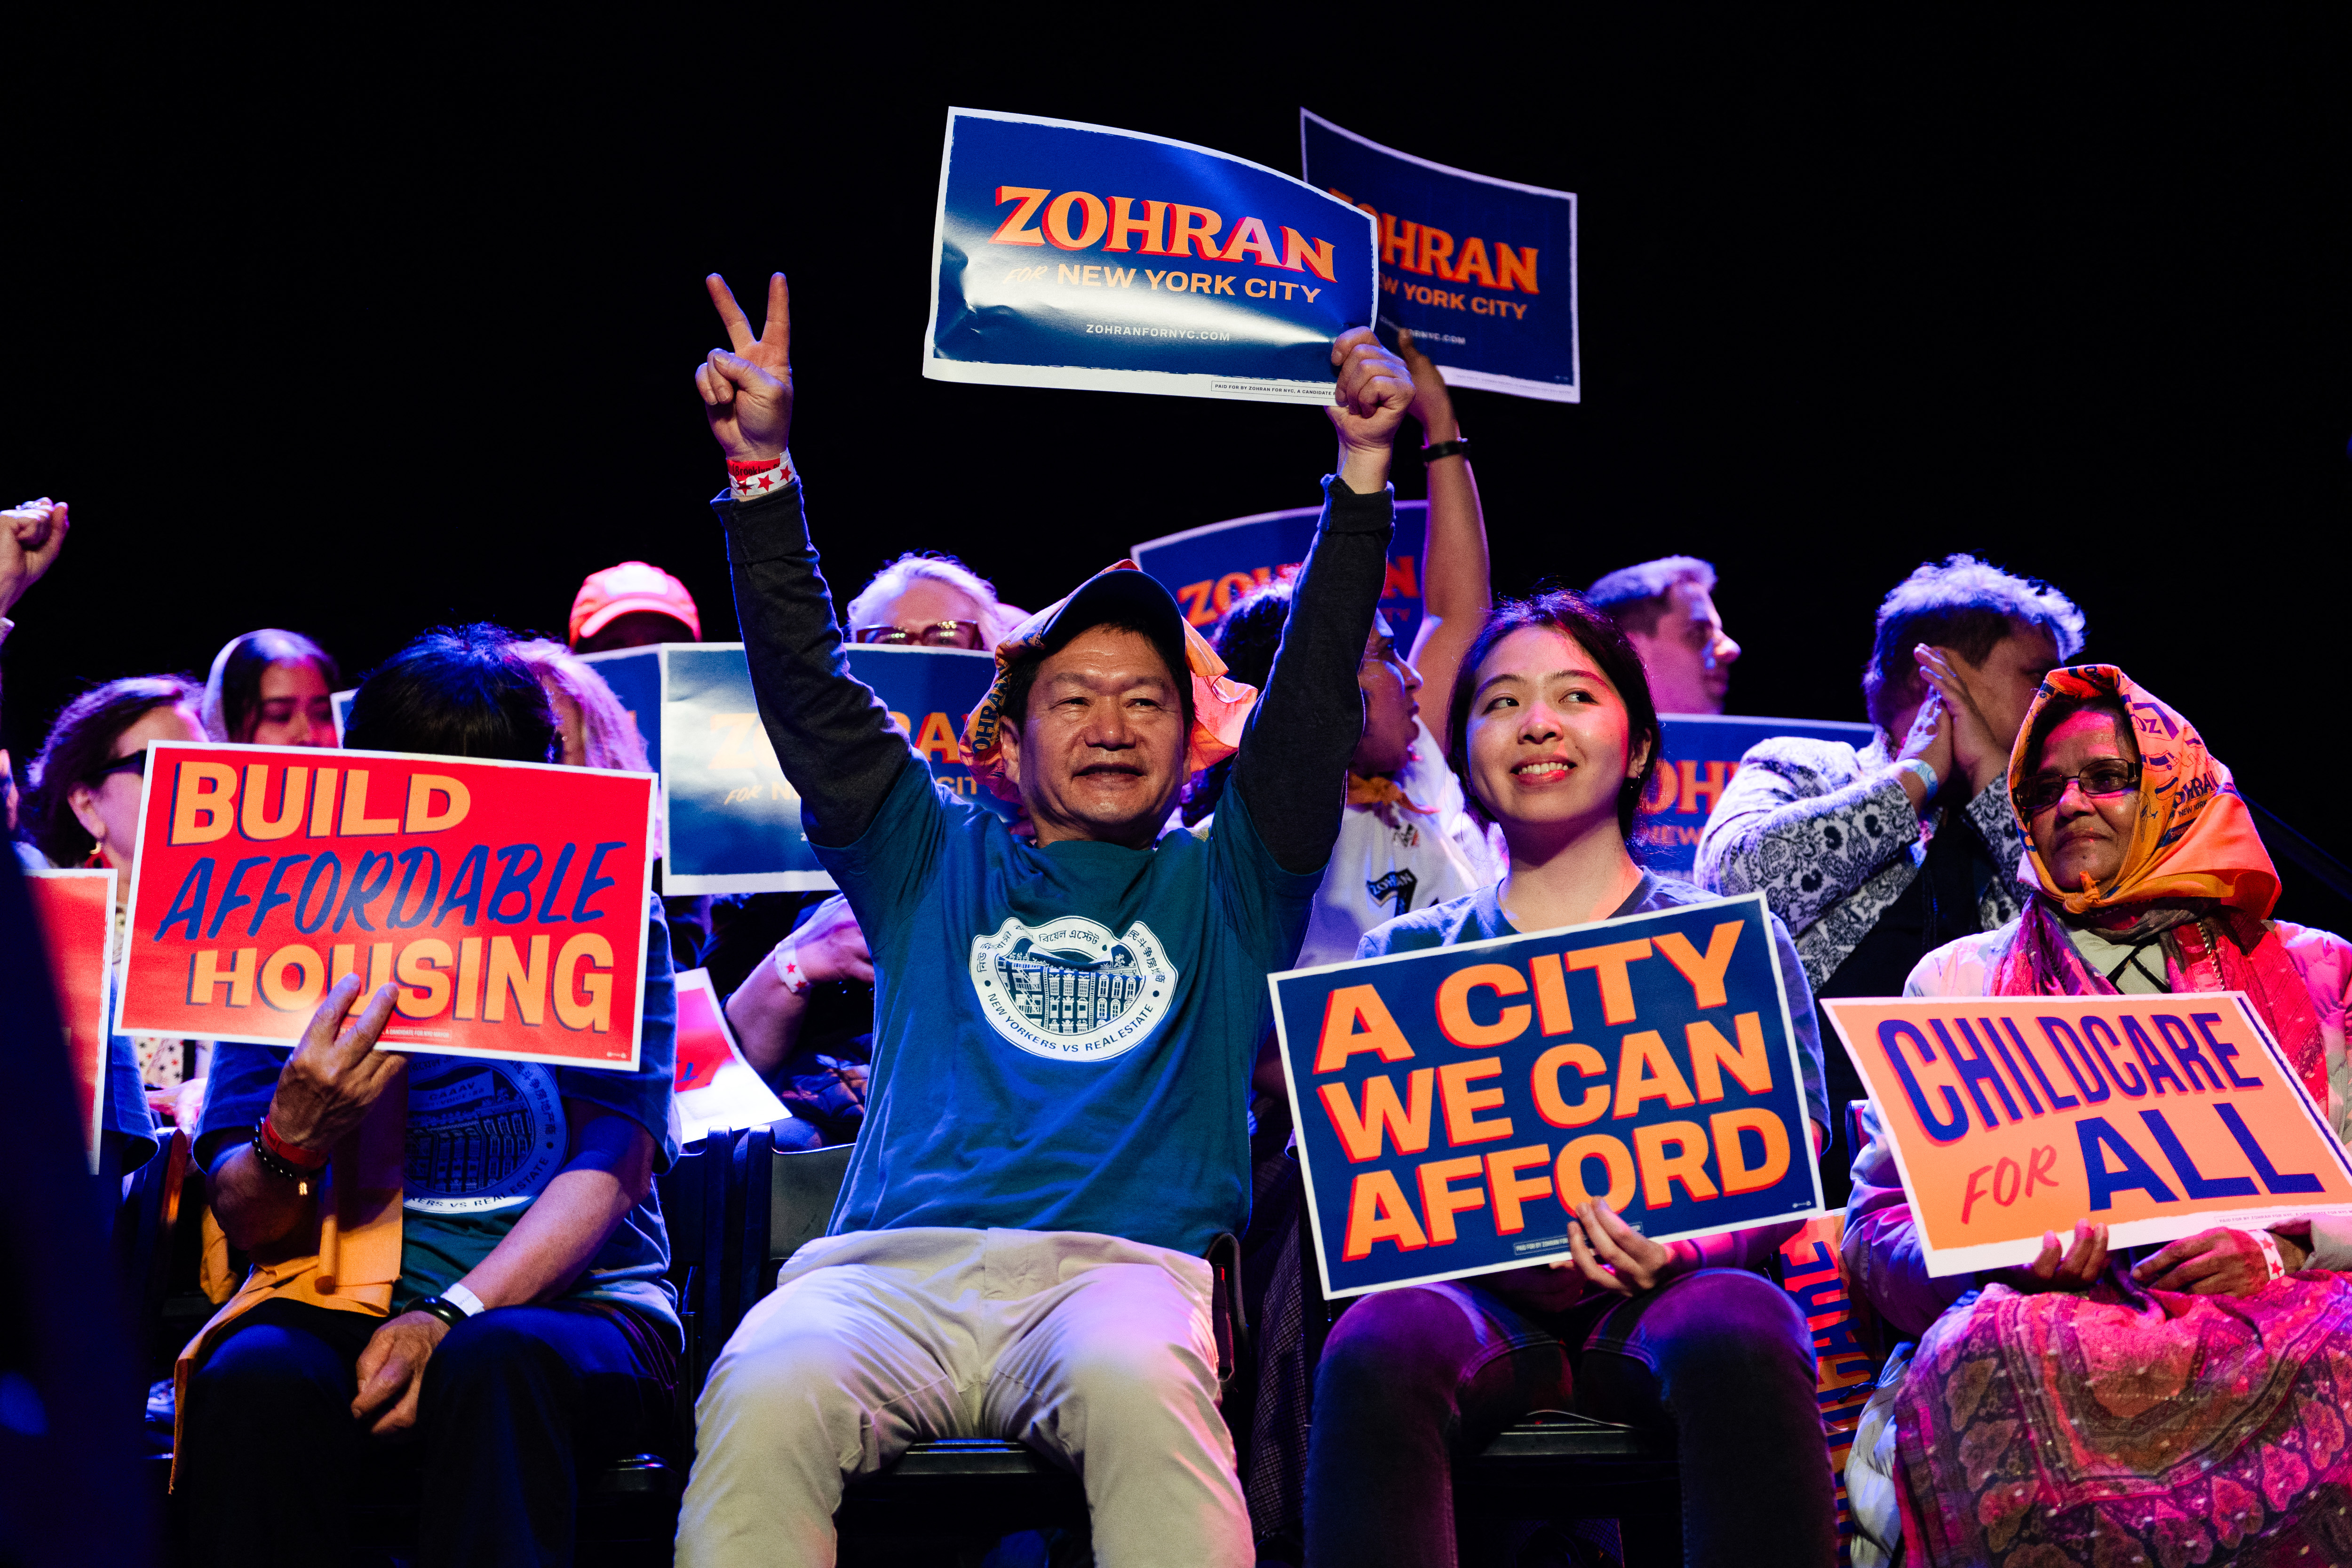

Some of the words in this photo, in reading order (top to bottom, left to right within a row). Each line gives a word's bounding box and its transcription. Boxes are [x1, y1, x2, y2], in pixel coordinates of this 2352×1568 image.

[988, 186, 1337, 283] ZOHRAN
[1328, 188, 1540, 295] HRAN
[1003, 265, 1048, 284] FOR
[1058, 263, 1136, 289] NEW
[1144, 269, 1237, 295] YORK
[1245, 278, 1321, 303] CITY
[1403, 282, 1466, 311] YORK
[1471, 296, 1527, 320] CITY
[1086, 324, 1231, 342] ZOHRANFORNYC.COM
[972, 676, 1009, 753] OHRAN
[169, 761, 471, 846] BUILD
[724, 784, 763, 805] FOR
[2178, 806, 2192, 817] NEW
[154, 842, 627, 941] AFFORDABLE
[186, 932, 614, 1034] HOUSING
[988, 993, 1007, 1016] NEW
[1005, 1014, 1057, 1050] YORKERS
[1063, 1044, 1079, 1052] VS
[1085, 1035, 1118, 1051] REAL
[1120, 1003, 1154, 1037] ESTATE
[1313, 984, 1415, 1075] A
[1436, 920, 1745, 1049] CITY
[1317, 1057, 1513, 1163] WE
[1531, 1011, 1774, 1129] CAN
[1877, 1012, 2264, 1147] CHILDCARE
[474, 1193, 508, 1206] REAL
[510, 1157, 549, 1194] ESTATE
[1342, 1108, 1791, 1262] AFFORD
[1961, 1144, 2058, 1224] FOR
[2075, 1102, 2326, 1211] ALL
